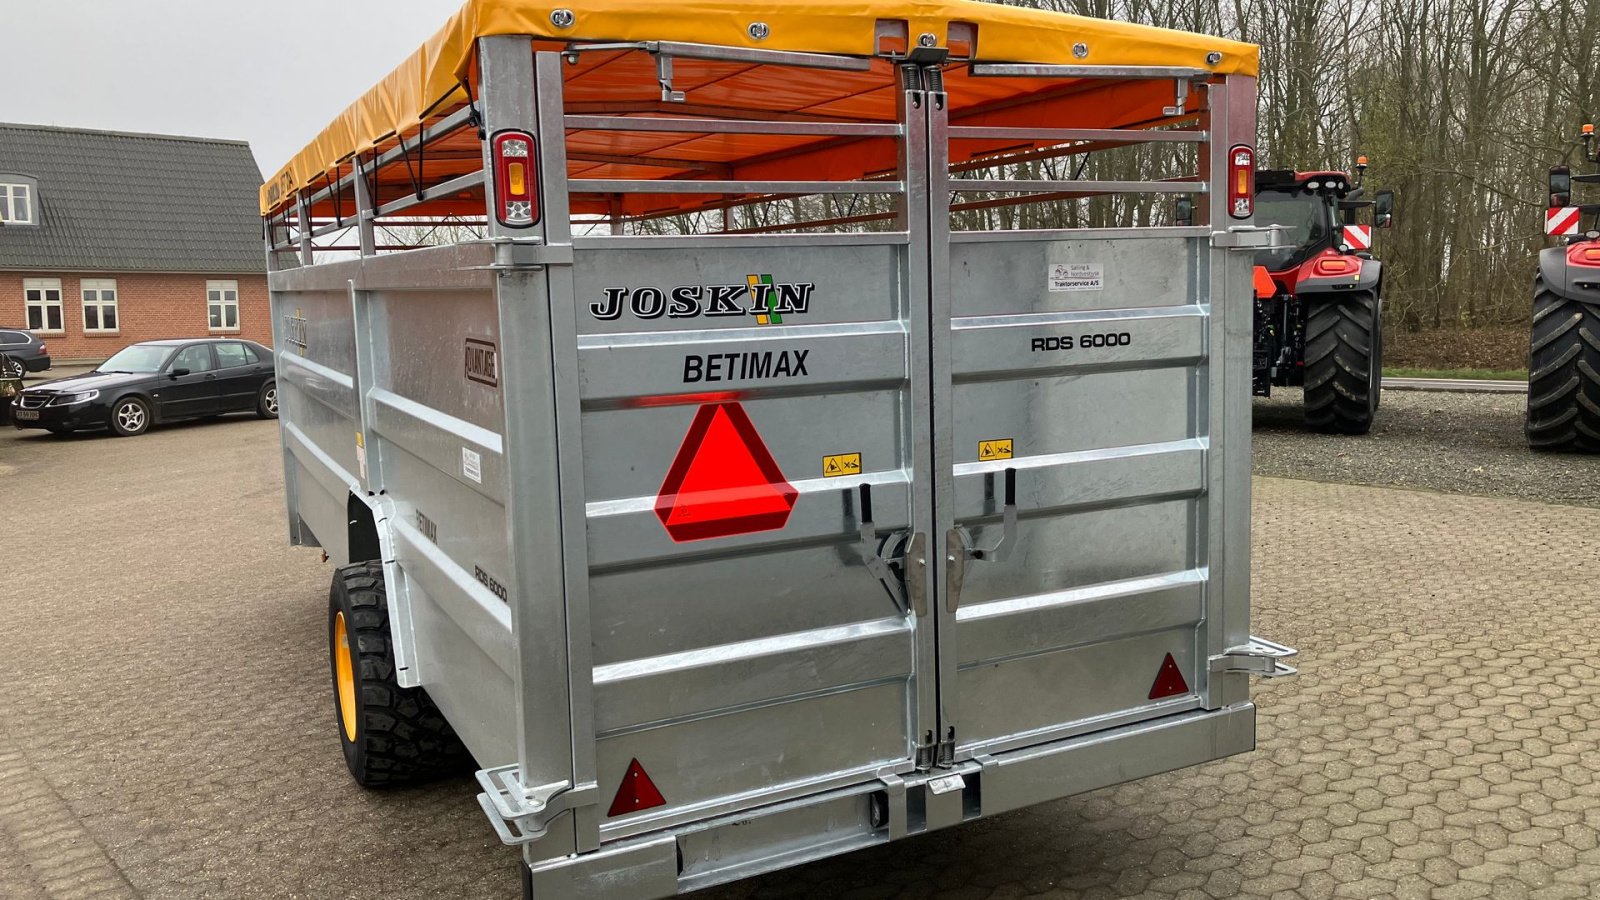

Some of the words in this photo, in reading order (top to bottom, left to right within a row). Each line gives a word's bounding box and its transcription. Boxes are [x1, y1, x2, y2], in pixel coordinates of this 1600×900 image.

[588, 283, 815, 320] JOSKIN
[1031, 336, 1073, 352] RDS
[1080, 332, 1131, 347] 6000
[683, 350, 809, 383] BETIMAX
[475, 564, 488, 587] RDS
[489, 577, 507, 603] 6000
